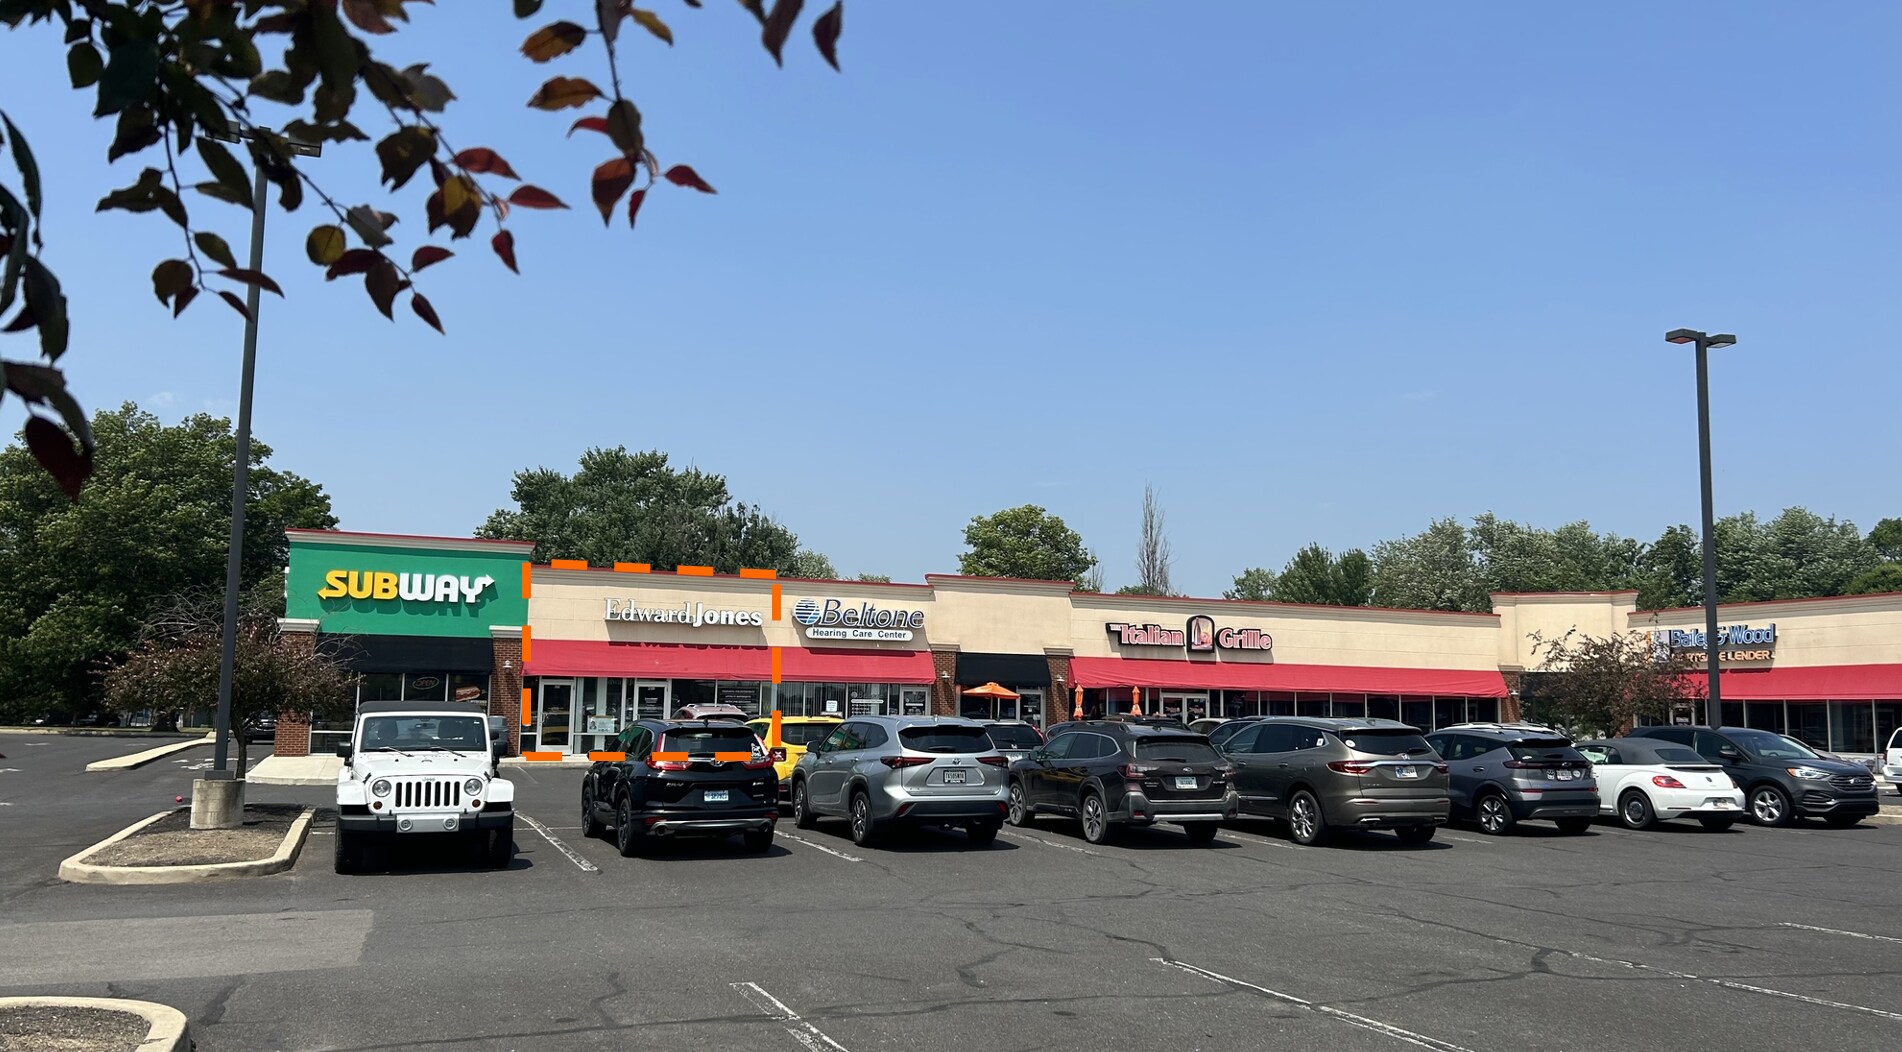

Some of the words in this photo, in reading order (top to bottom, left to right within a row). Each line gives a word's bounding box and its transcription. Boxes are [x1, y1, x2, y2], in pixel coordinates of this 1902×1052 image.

[316, 570, 496, 603] SUBWAY
[819, 598, 926, 629] Beltone
[812, 628, 847, 639] Hearing
[852, 629, 873, 639] Care
[877, 630, 907, 640] Center
[1120, 624, 1185, 646] Italian
[1218, 627, 1272, 650] Grille
[1728, 623, 1775, 645] Wood
[1728, 650, 1771, 662] LENDER
